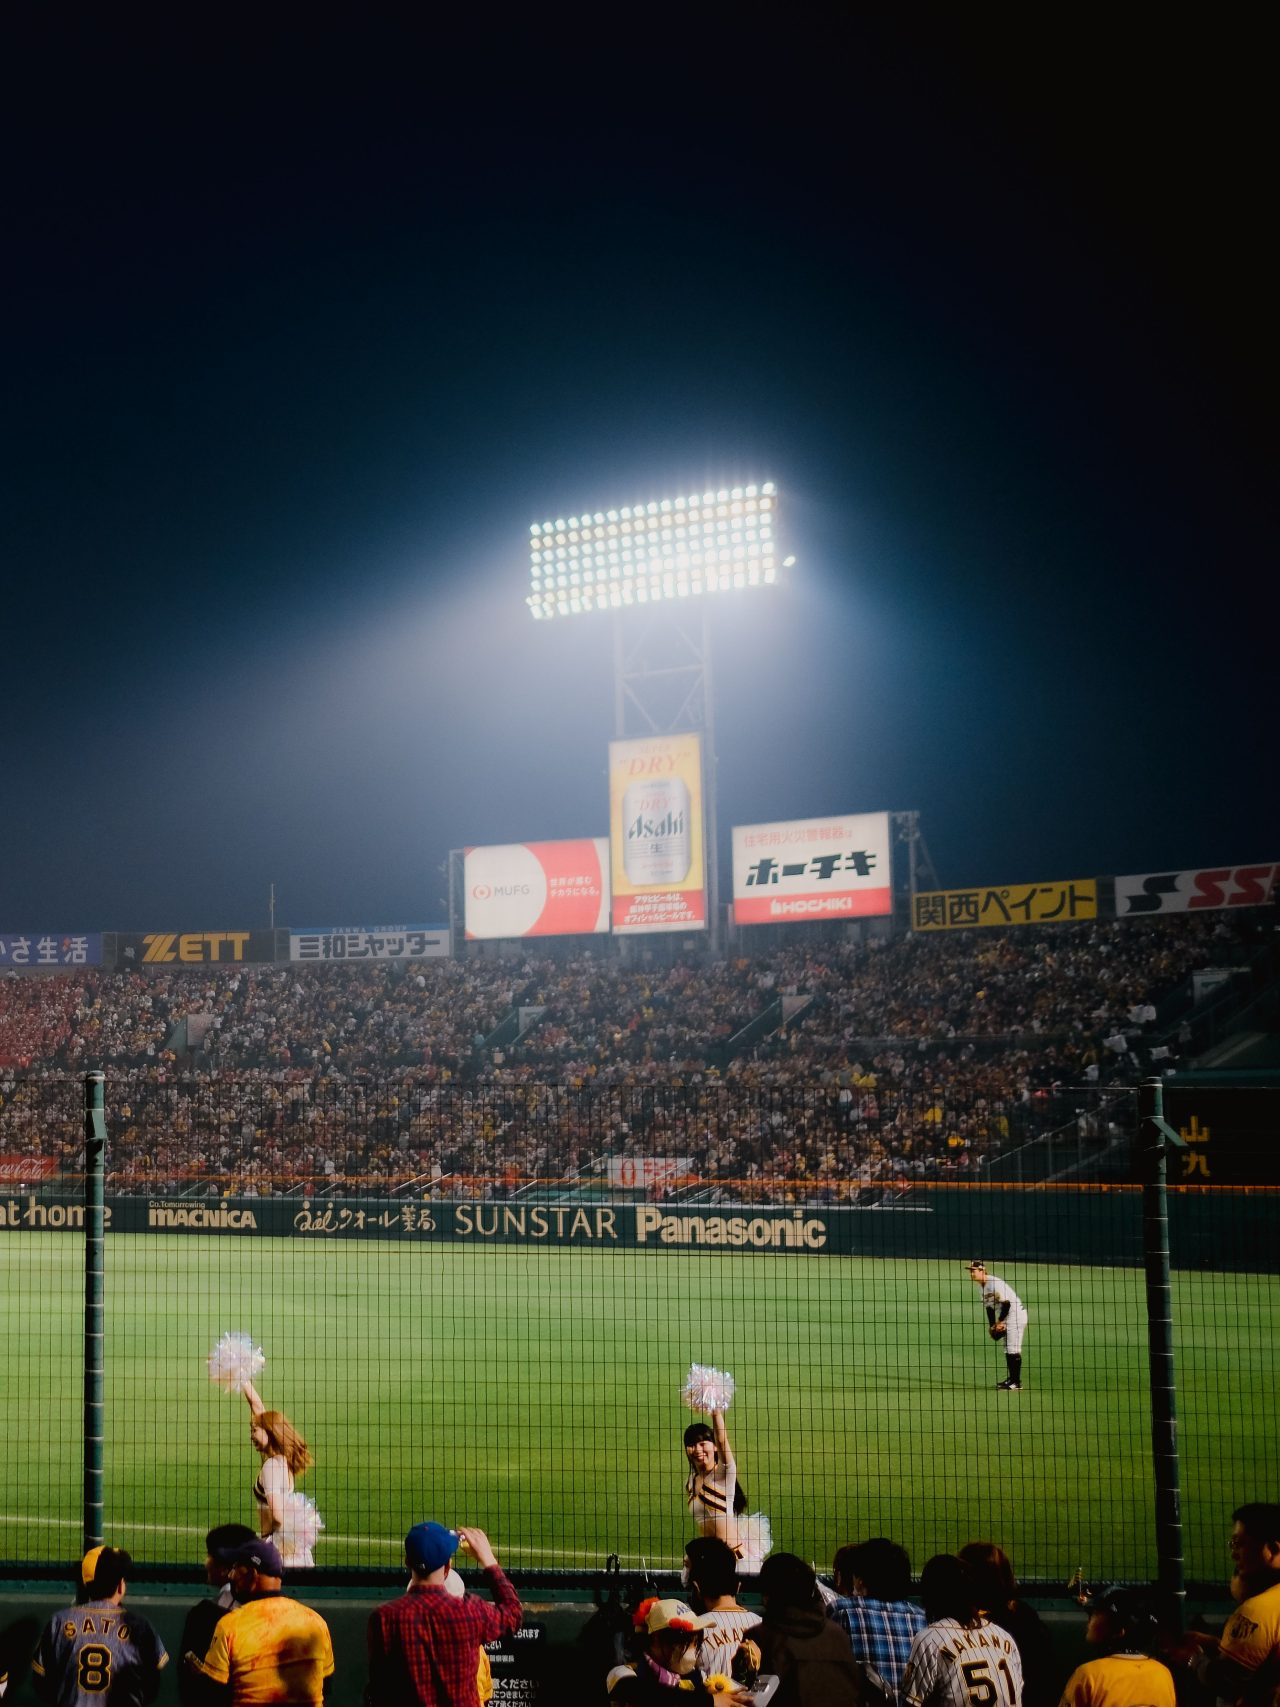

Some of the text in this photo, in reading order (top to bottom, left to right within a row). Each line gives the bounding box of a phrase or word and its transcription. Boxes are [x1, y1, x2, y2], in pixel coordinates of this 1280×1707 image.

[628, 811, 684, 840] Asahi
[745, 850, 877, 886] ホーチキ
[494, 885, 530, 896] MUFG
[1187, 864, 1280, 909] SS
[781, 897, 853, 914] HOCHIKI
[915, 884, 1094, 927] 関西ペイント
[141, 932, 250, 962] ZETT
[299, 932, 441, 959] 三和シャッター
[340, 1205, 437, 1233] クオール薬局
[455, 1204, 618, 1239] SUNSTAR
[635, 1206, 827, 1248] Panasonic
[63, 1616, 130, 1641] SATO
[513, 1628, 540, 1639] られます
[939, 1632, 1012, 1663] NAKANO
[77, 1643, 112, 1694] 8
[960, 1657, 1017, 1707] 51
